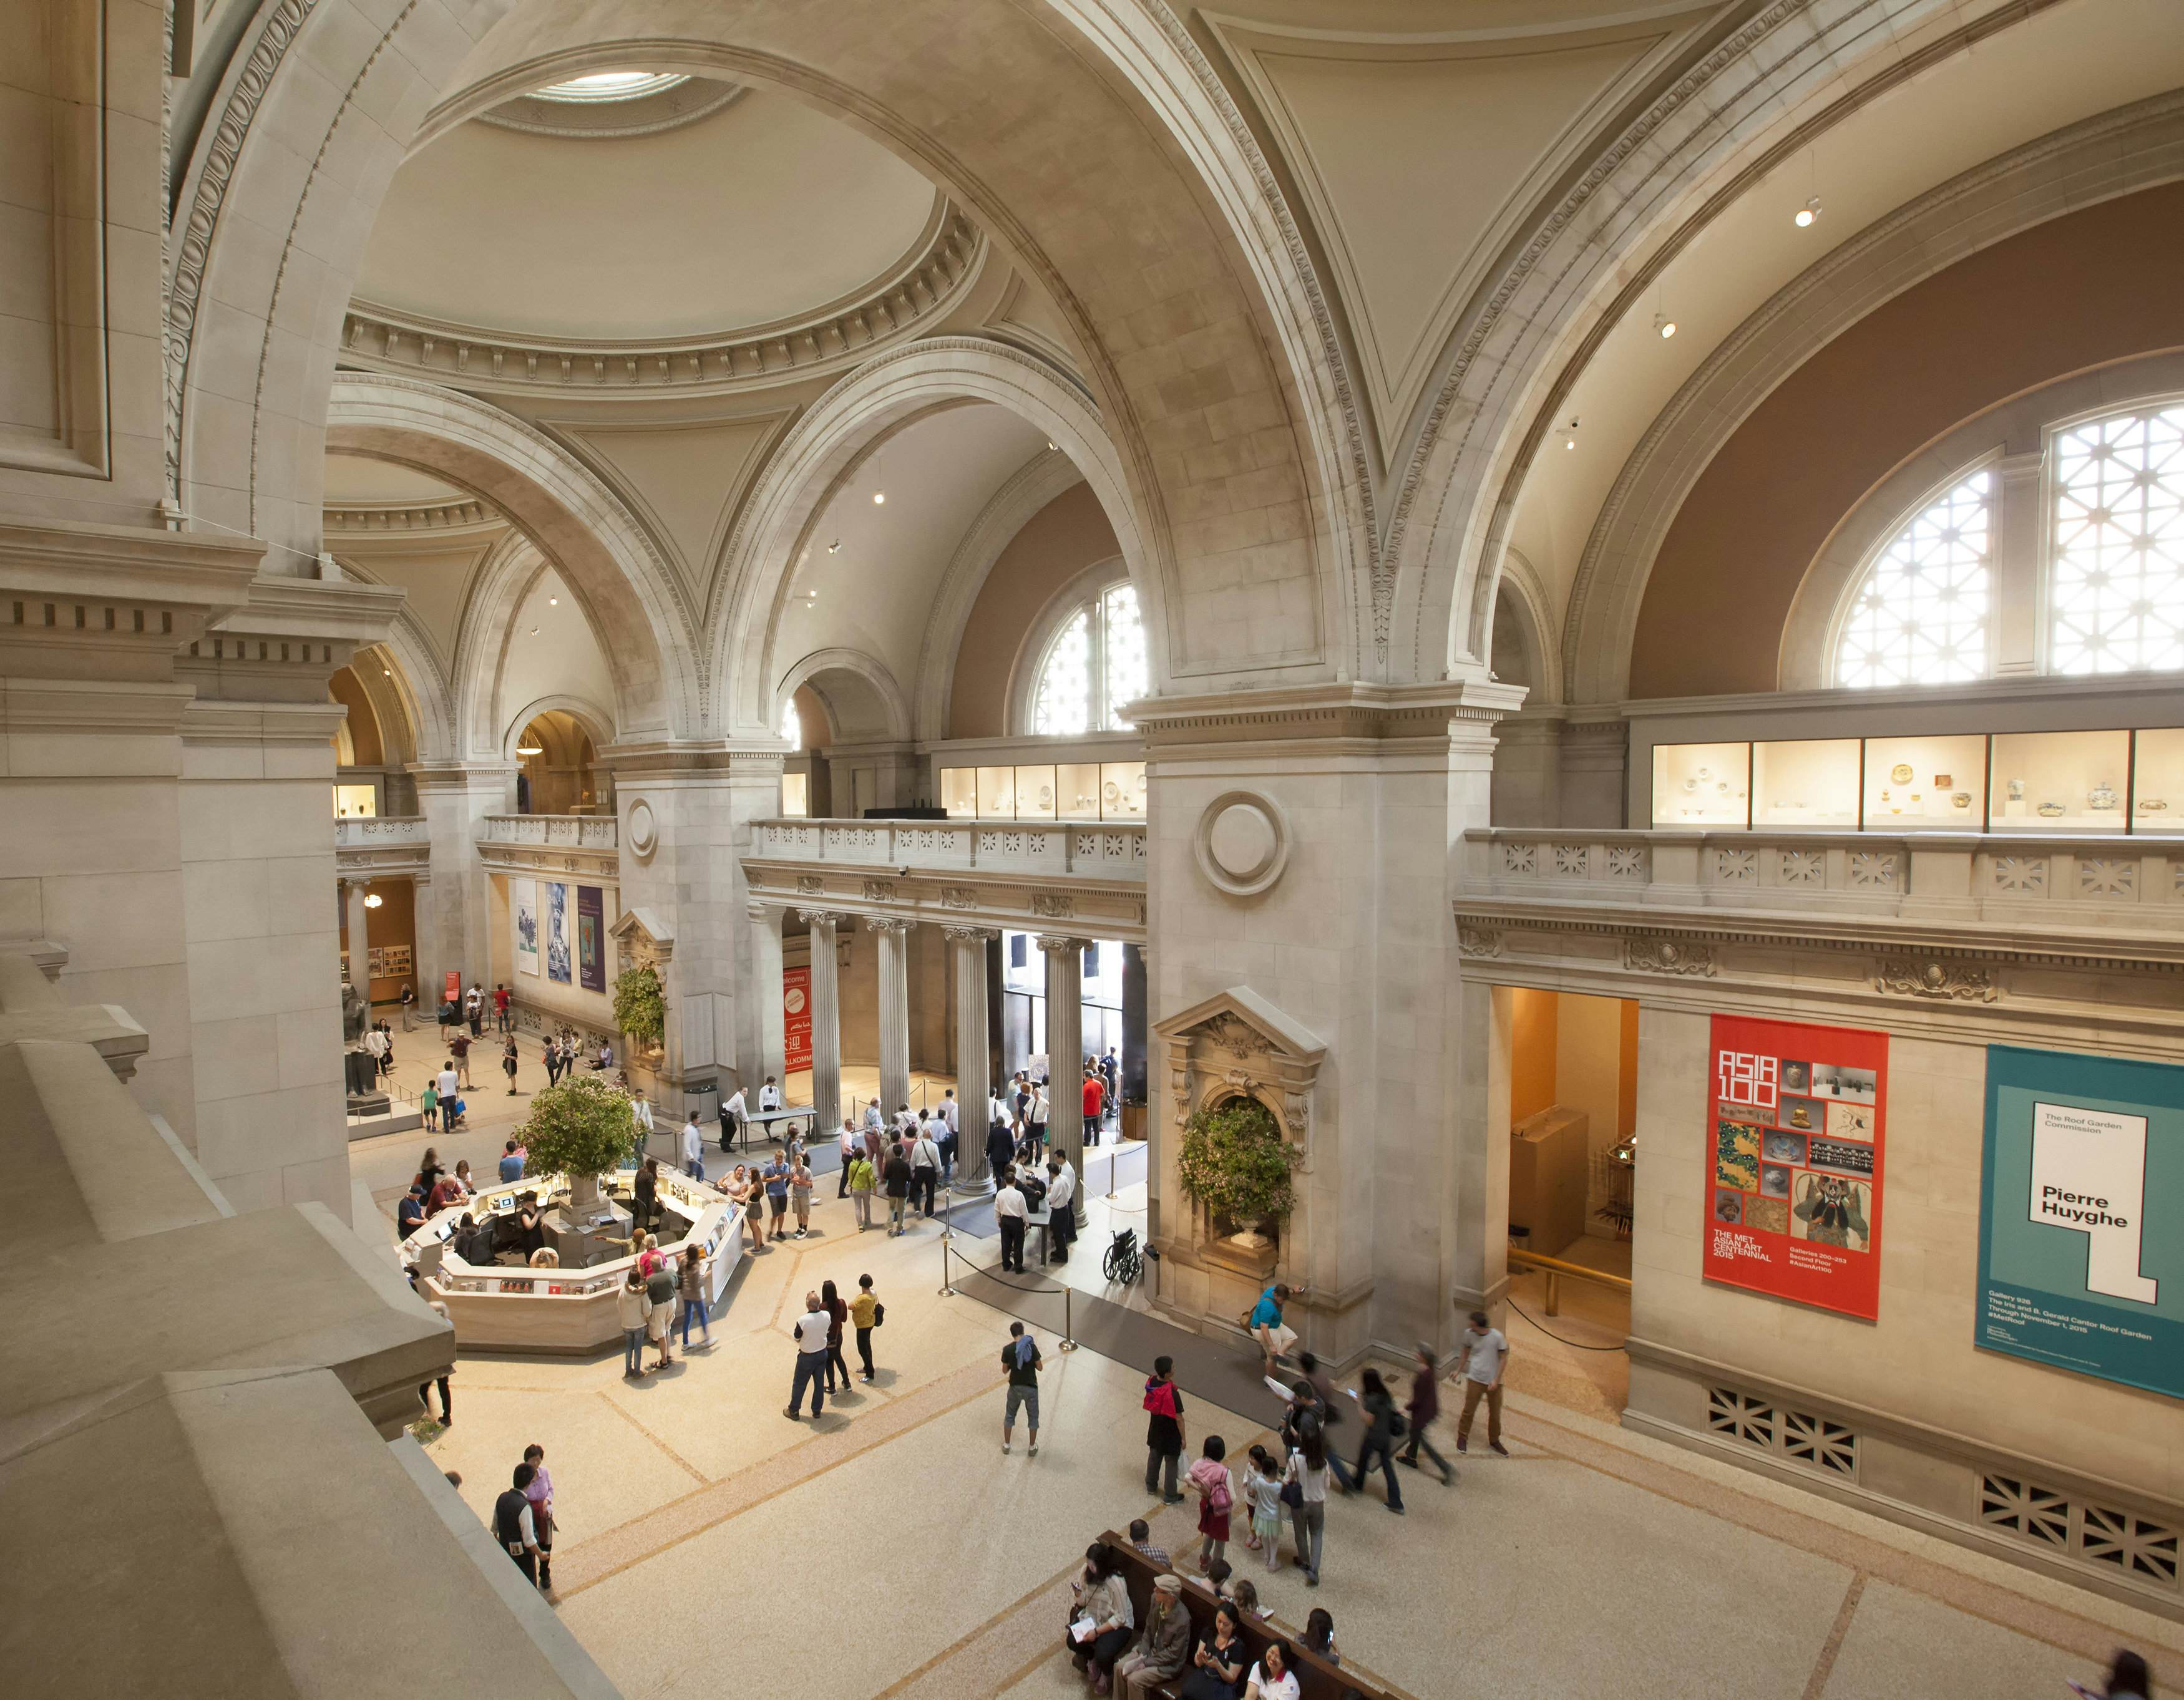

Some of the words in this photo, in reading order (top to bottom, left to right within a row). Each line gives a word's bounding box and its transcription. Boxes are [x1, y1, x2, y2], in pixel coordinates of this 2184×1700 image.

[783, 976, 805, 984] elcome
[784, 1055, 812, 1066] ILLKOMM
[1718, 1050, 1778, 1082] ASIA
[1718, 1075, 1777, 1109] 100
[2045, 1113, 2062, 1121] The
[2064, 1116, 2085, 1125] Roof
[2087, 1120, 2122, 1130] Garden
[2045, 1120, 2102, 1134] Commission
[2042, 1185, 2108, 1208] Pierre
[2042, 1201, 2128, 1228] Huyghe
[1714, 1228, 1732, 1239] THE
[1735, 1233, 1754, 1243] MET
[1714, 1236, 1742, 1248] ASIAN
[1744, 1243, 1763, 1253] ART
[1714, 1242, 1772, 1262] CENTENNIAL
[1790, 1246, 1818, 1257] Galleries
[1714, 1248, 1734, 1260] 2015
[1790, 1253, 1813, 1263] Second
[1815, 1258, 1832, 1267] Floor
[1789, 1260, 1832, 1273] #AsianArt100
[1988, 1290, 2016, 1302] Gallery
[1987, 1311, 2026, 1326] #MetRoof
[1988, 1296, 2003, 1306] The
[2004, 1301, 2016, 1309] Iris
[2017, 1304, 2032, 1313] and
[2042, 1310, 2070, 1322] Gerald
[2070, 1317, 2099, 1328] Cantor
[2100, 1323, 2119, 1333] Roof
[2120, 1328, 2153, 1341] Garden
[1988, 1304, 2019, 1317] Through
[2021, 1312, 2060, 1327] November
[2069, 1324, 2087, 1334] 2015
